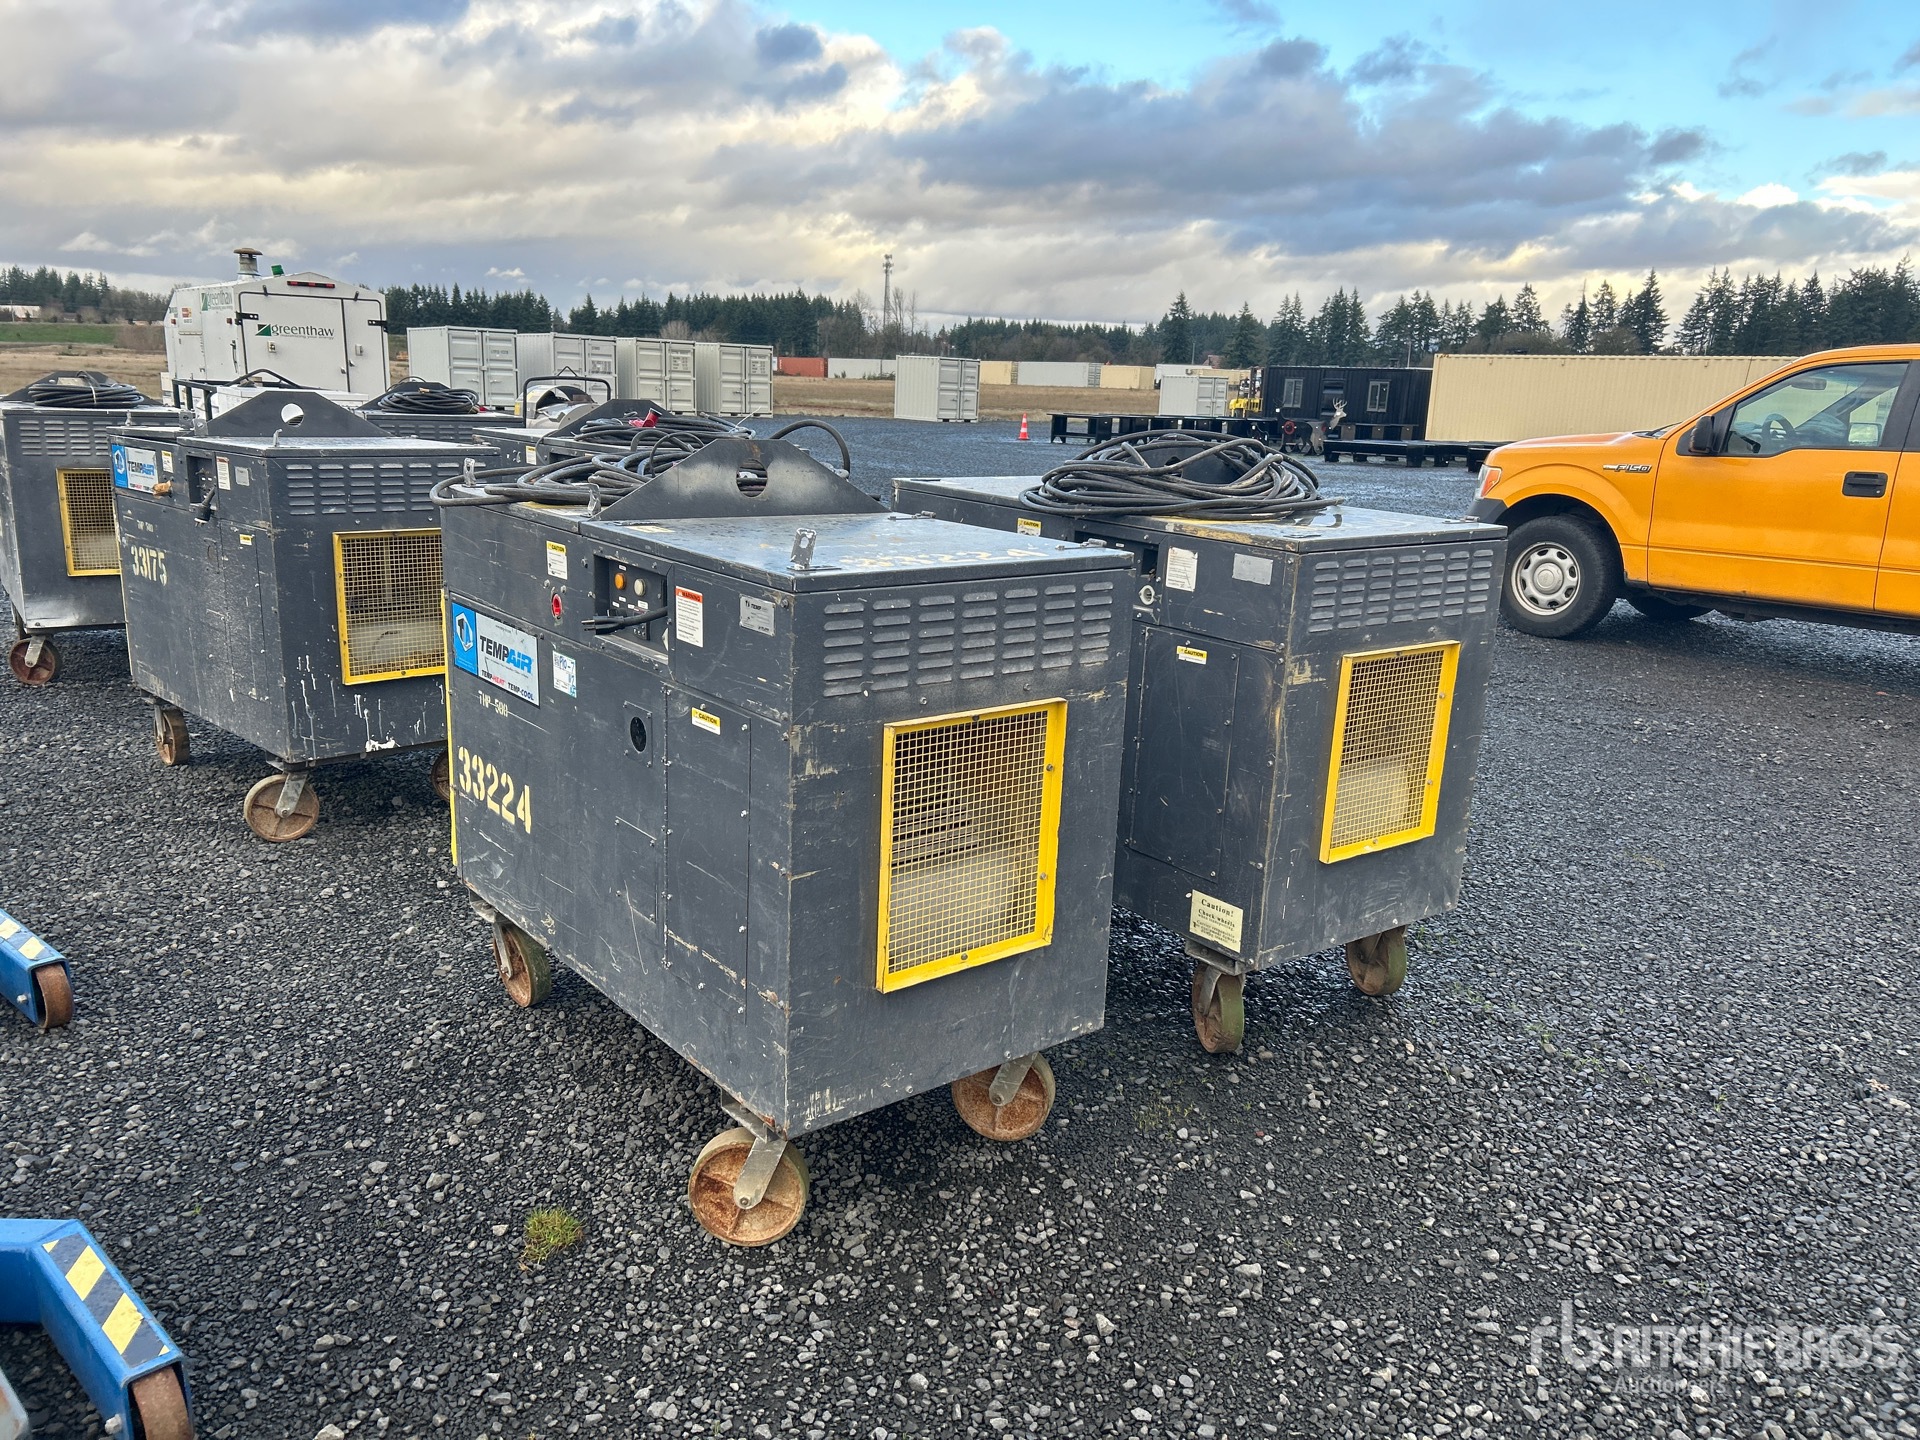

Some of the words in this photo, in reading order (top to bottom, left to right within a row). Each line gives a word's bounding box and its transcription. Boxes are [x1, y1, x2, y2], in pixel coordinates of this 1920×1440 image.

[271, 324, 335, 336] greenthaw
[551, 543, 566, 553] CAUTION
[131, 544, 168, 586] 33175
[682, 590, 701, 602] WARNING
[479, 634, 534, 674] TEMPAIR
[1184, 649, 1205, 658] CAUTION
[507, 681, 534, 701] TEMP-COOL
[698, 711, 718, 725] CAUTION
[457, 745, 532, 834] 33224
[1201, 899, 1233, 917] Caution!
